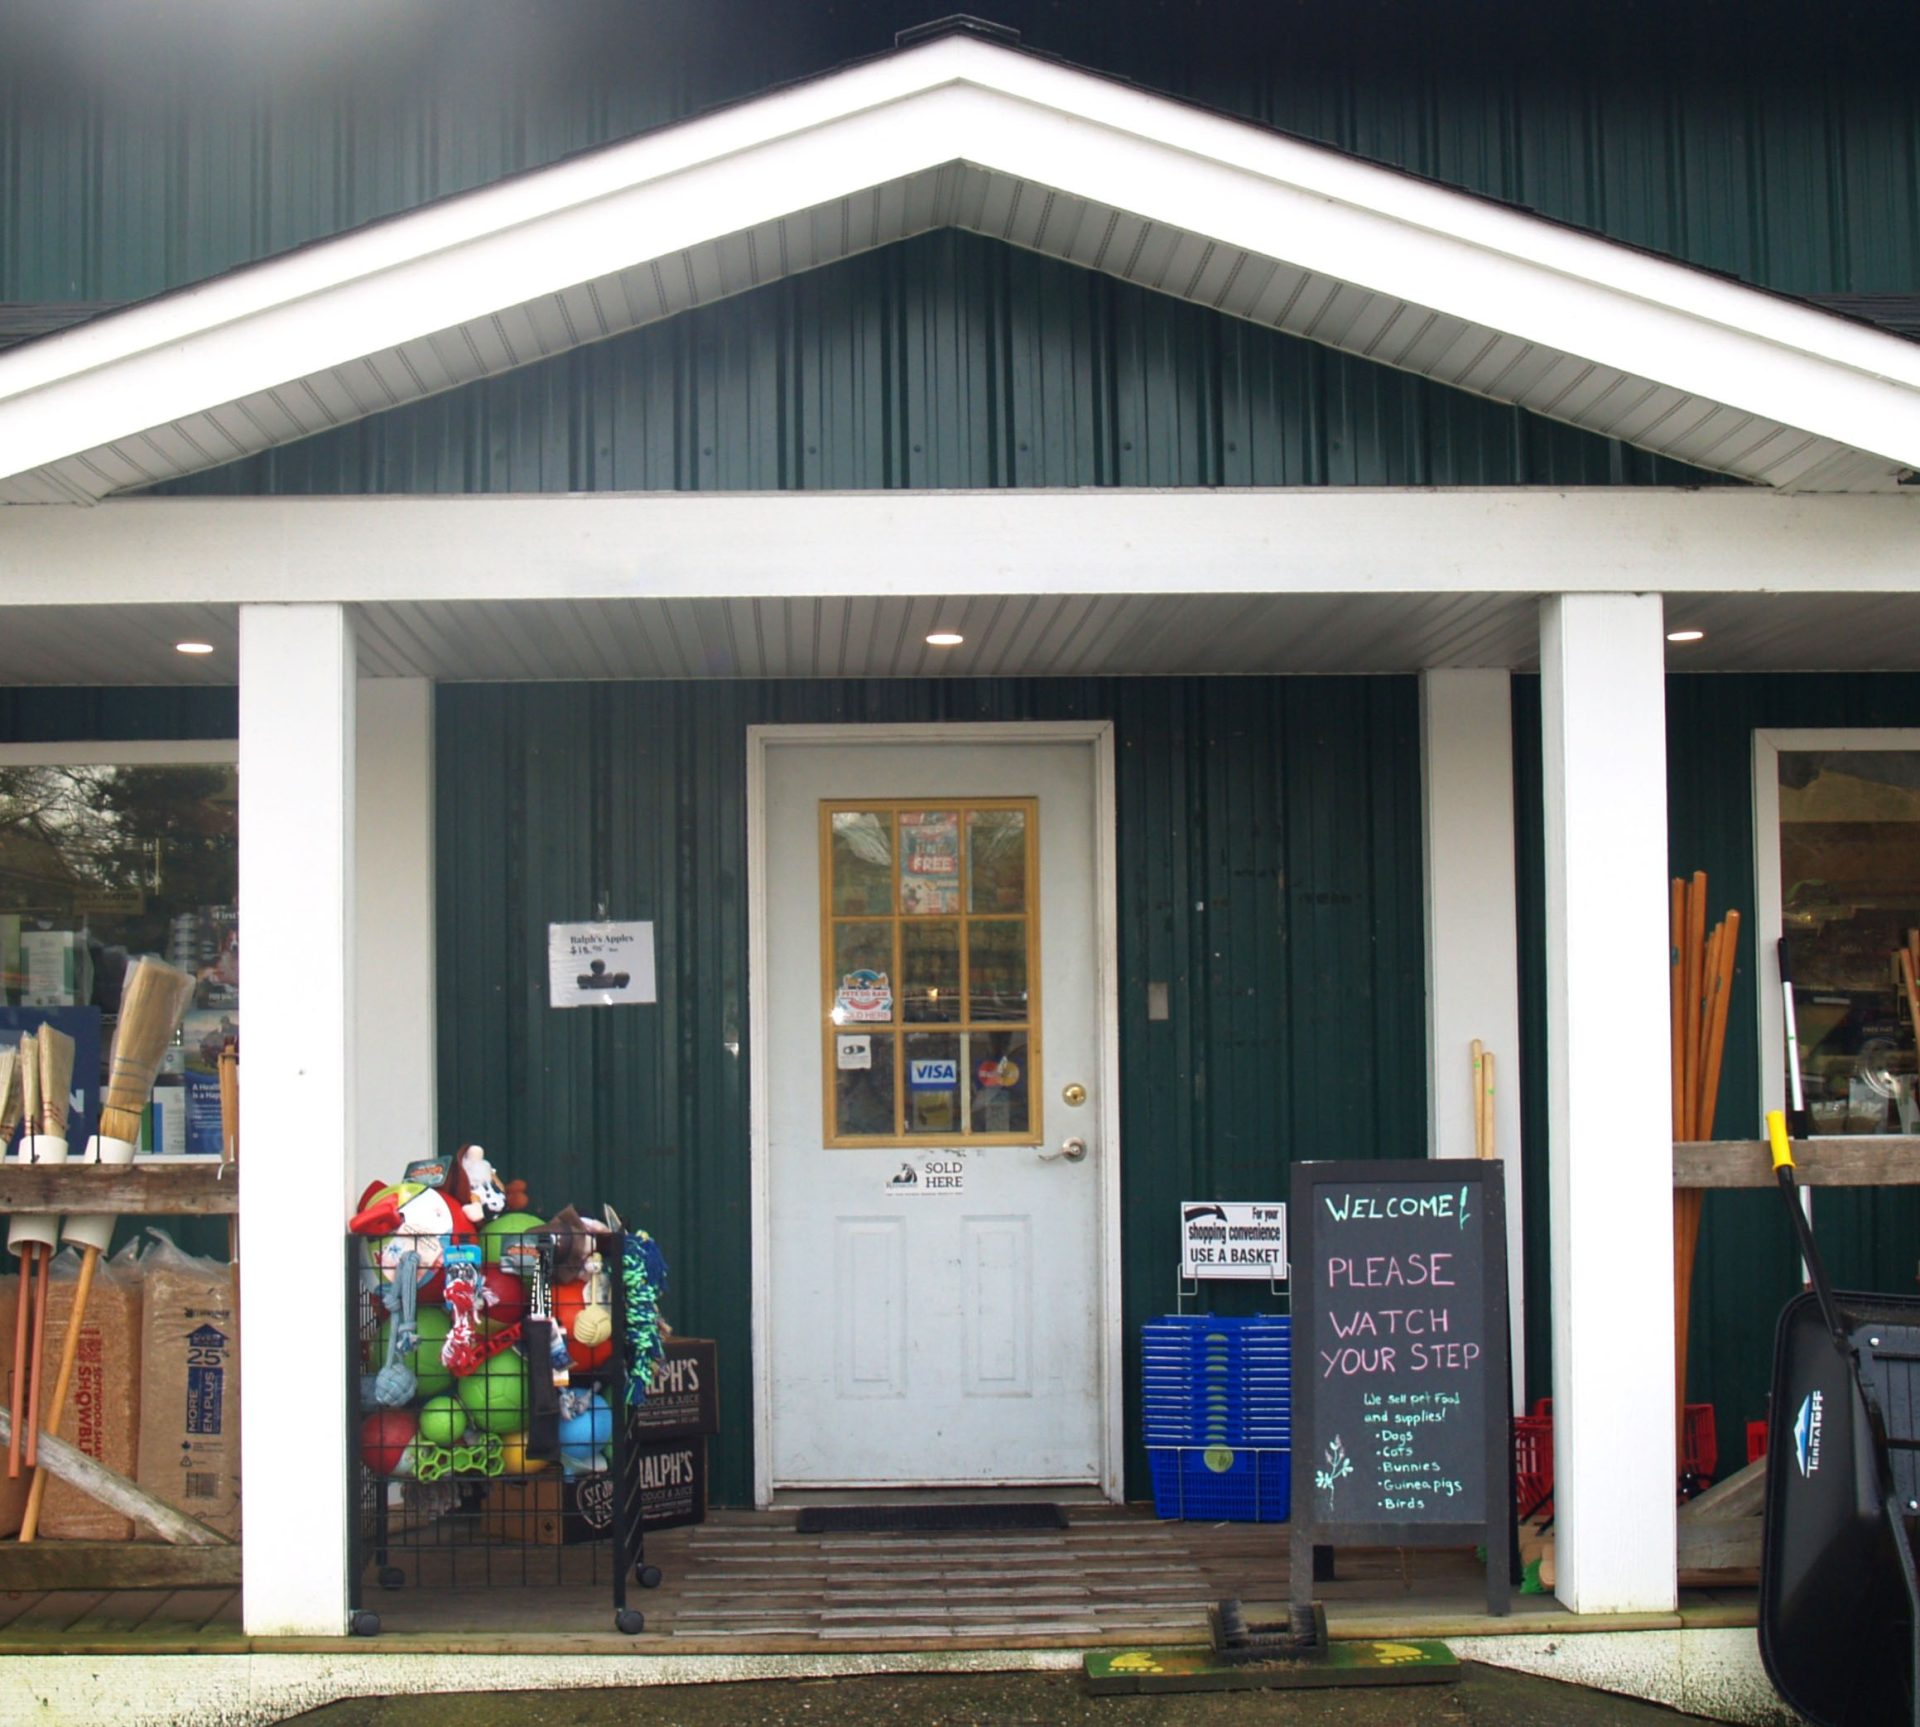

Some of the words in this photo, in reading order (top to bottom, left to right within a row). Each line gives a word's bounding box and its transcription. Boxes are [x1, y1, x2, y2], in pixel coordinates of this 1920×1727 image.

[913, 856, 951, 871] FREE
[570, 935, 602, 944] Ralph's
[604, 934, 634, 943] Apples
[917, 1065, 954, 1079] VISA
[925, 1162, 963, 1174] SOLD
[926, 1176, 963, 1188] HERE
[1252, 1207, 1262, 1219] For
[1264, 1210, 1279, 1221] your
[1189, 1222, 1226, 1244] shopping
[1229, 1222, 1280, 1241] convenience
[1190, 1248, 1214, 1262] USE
[1218, 1248, 1226, 1262] A
[1230, 1249, 1279, 1263] BASKET
[1328, 1253, 1456, 1287] PLEASE
[1329, 1309, 1448, 1338] WATCH
[1320, 1347, 1396, 1378] YOUR
[1410, 1343, 1480, 1370] STEP
[93, 1366, 102, 1428] SOFTWOOD
[204, 1371, 216, 1408] PLUS
[1364, 1393, 1381, 1405] We
[1387, 1394, 1407, 1404] sell
[1410, 1391, 1430, 1407] pet
[188, 1389, 199, 1433] MORE
[1364, 1410, 1388, 1422] and
[1395, 1407, 1446, 1426] supplies!
[203, 1412, 213, 1433] EN
[93, 1431, 102, 1461] SHAV
[1382, 1430, 1413, 1447] Dogs
[1382, 1446, 1413, 1457] Cats
[1382, 1461, 1441, 1472] Bunnies
[1384, 1479, 1431, 1491] Guinea
[1433, 1477, 1463, 1496] pigs
[1385, 1497, 1425, 1509] Birds
